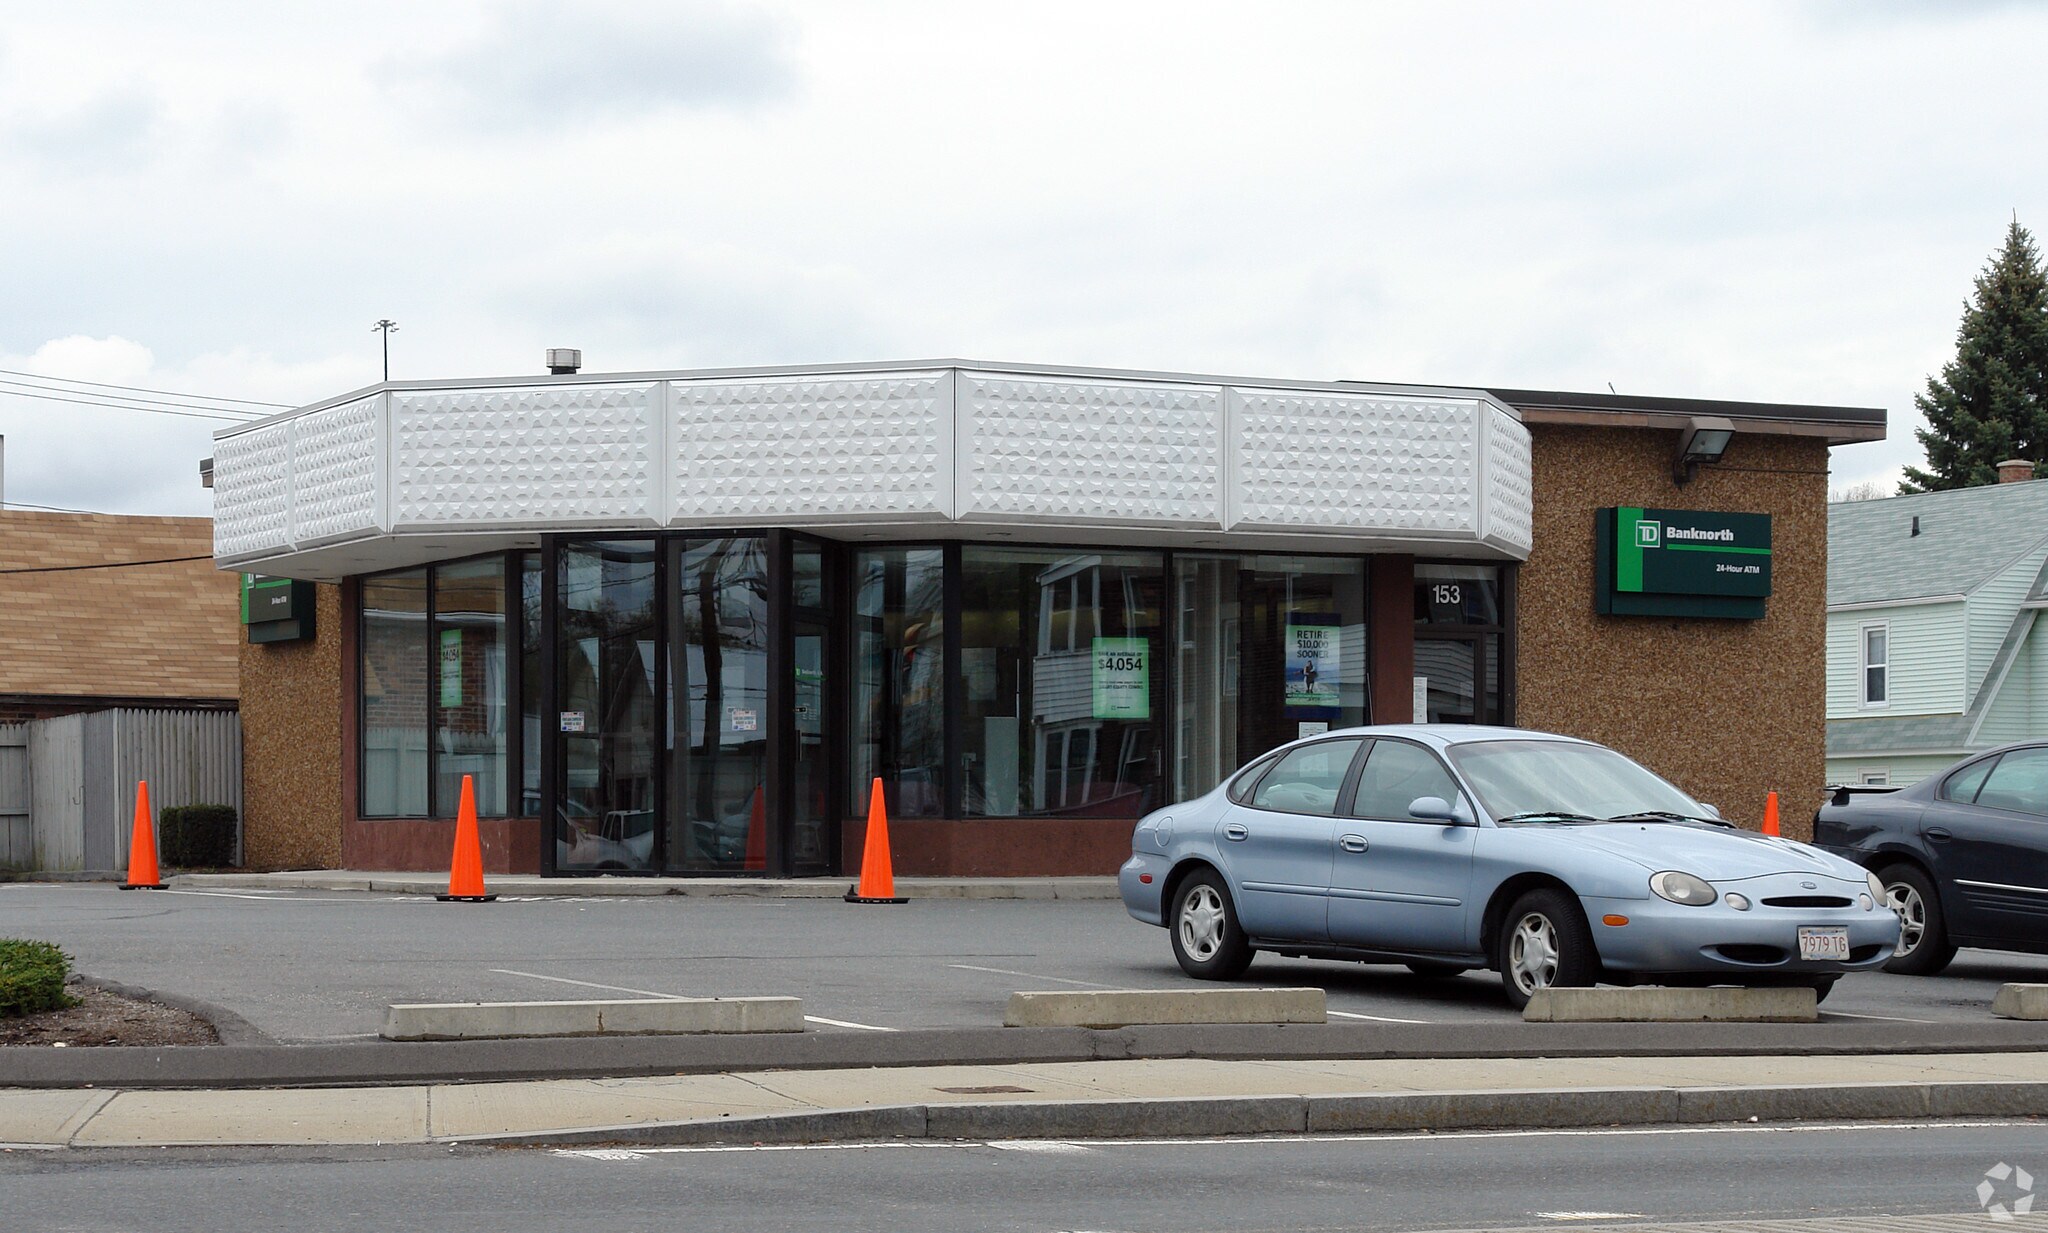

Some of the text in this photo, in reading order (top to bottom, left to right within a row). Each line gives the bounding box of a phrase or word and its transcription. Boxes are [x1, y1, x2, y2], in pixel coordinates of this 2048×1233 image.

[1638, 525, 1735, 542] TD Banknorth
[1716, 563, 1760, 574] 24-Hour ATM
[1432, 585, 1461, 604] 153
[1296, 630, 1329, 640] RETIRE
[1296, 640, 1329, 649] $10,000
[1296, 650, 1329, 659] SOONER
[1098, 657, 1143, 671] $4,054
[1801, 936, 1847, 953] 7979 TG
